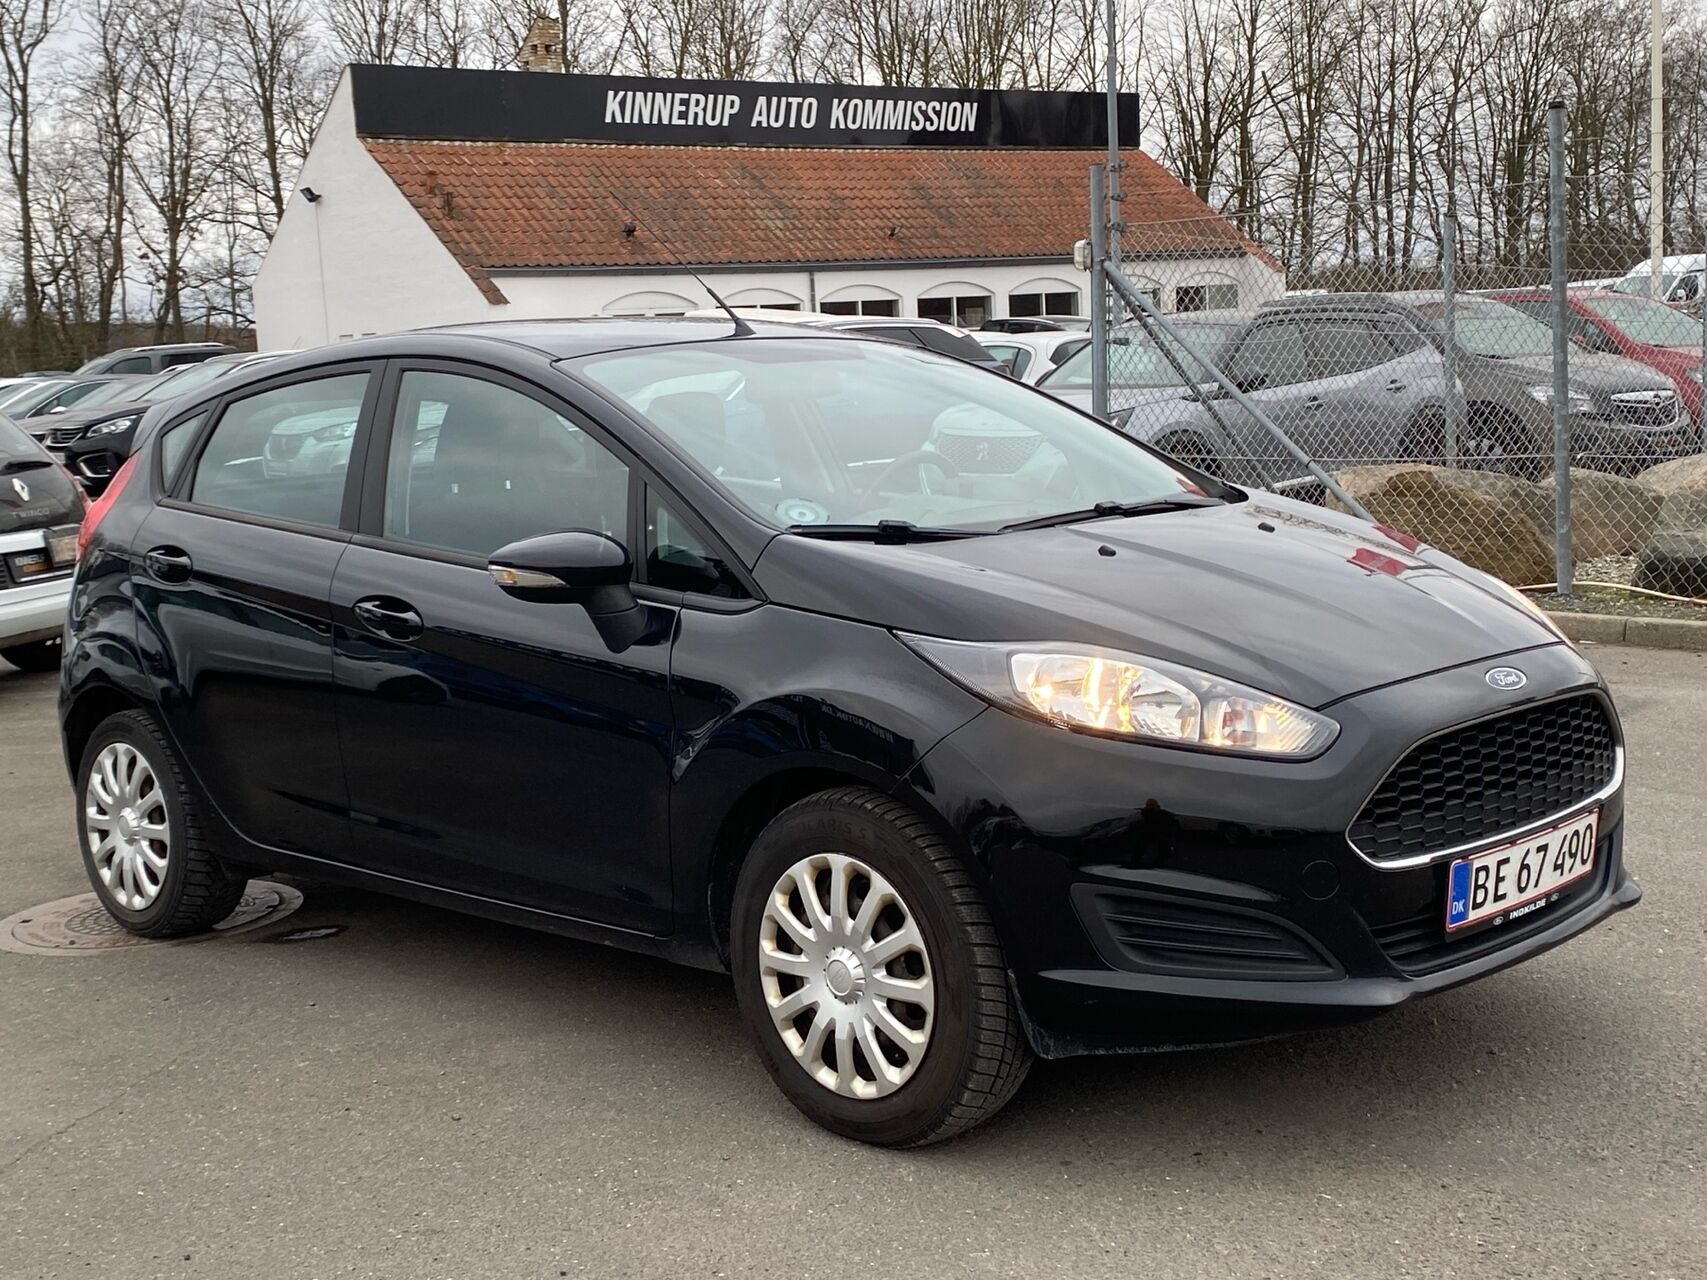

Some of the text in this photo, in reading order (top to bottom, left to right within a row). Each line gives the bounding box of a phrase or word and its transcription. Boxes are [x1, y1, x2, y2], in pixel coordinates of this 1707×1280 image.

[604, 90, 978, 132] KINNERUP AUTO KOMMISSION
[1494, 671, 1520, 685] Ford
[1471, 823, 1593, 911] BE 67 490
[1452, 900, 1465, 915] DK
